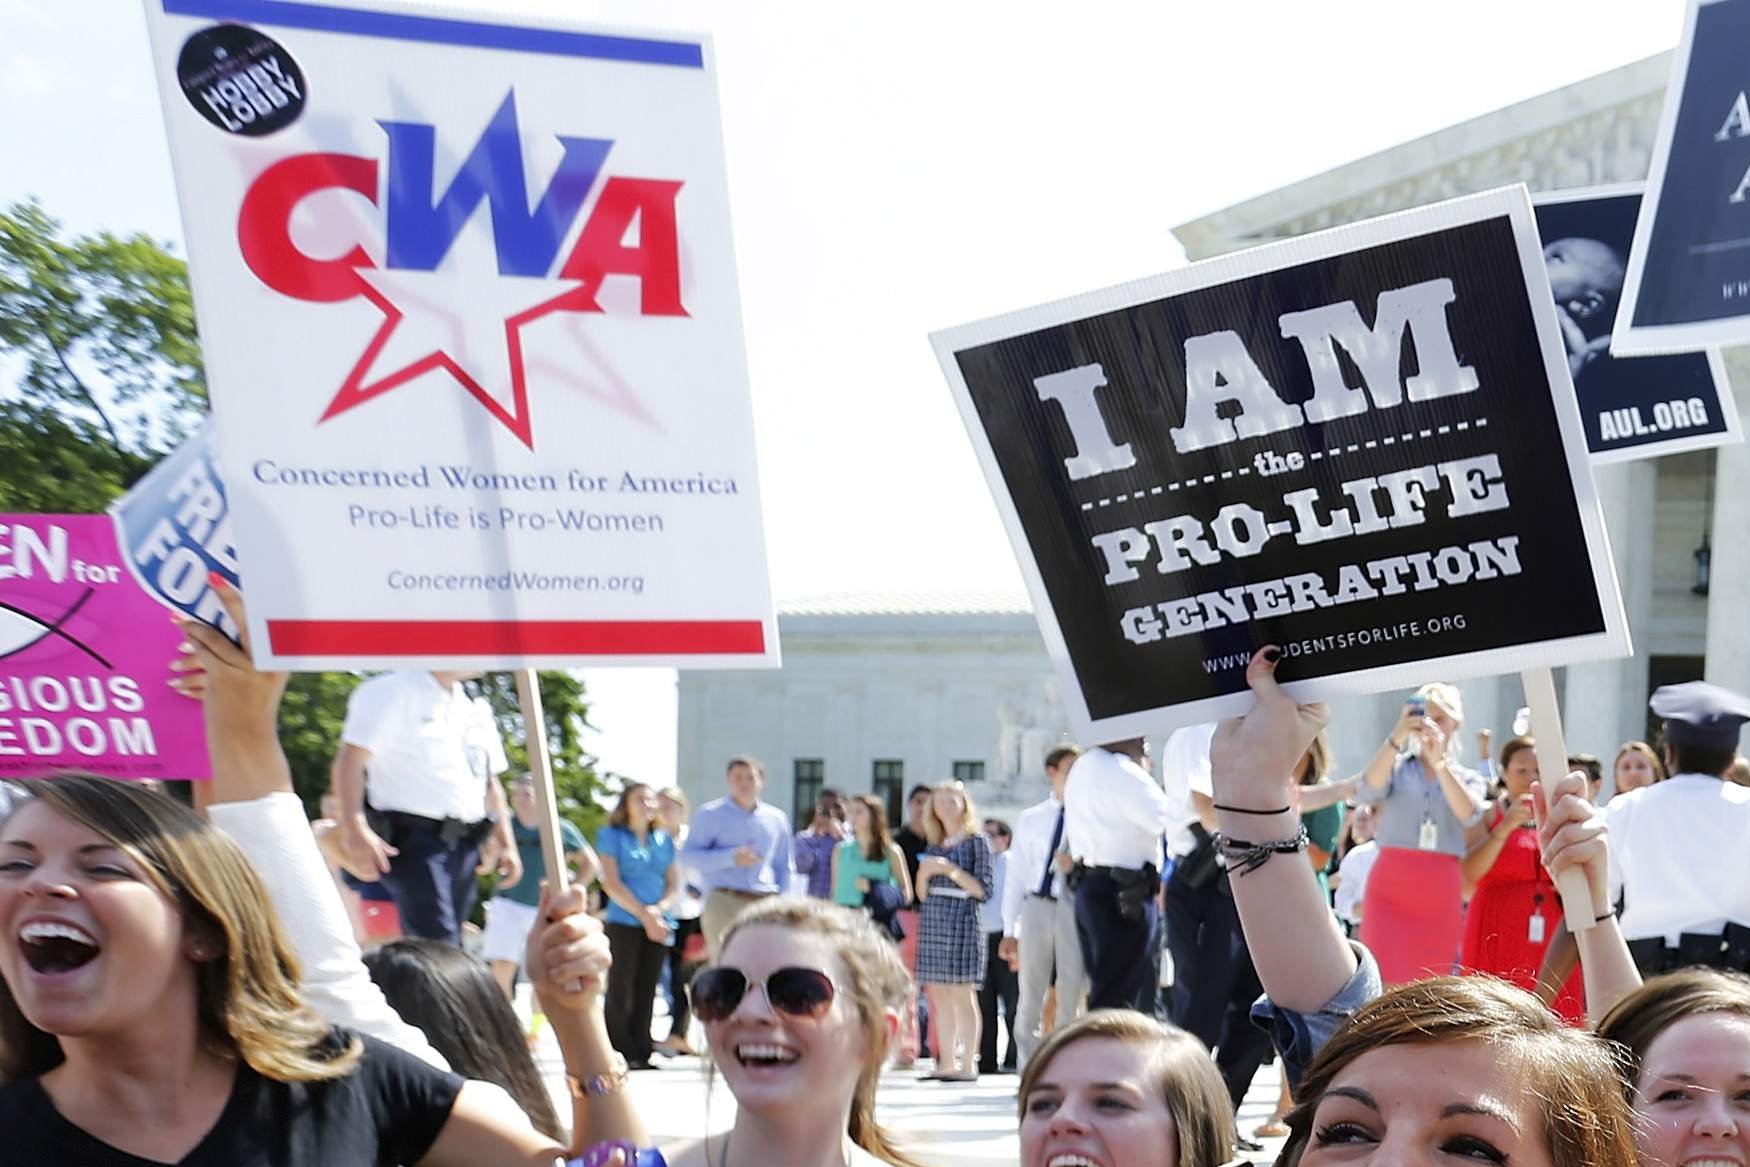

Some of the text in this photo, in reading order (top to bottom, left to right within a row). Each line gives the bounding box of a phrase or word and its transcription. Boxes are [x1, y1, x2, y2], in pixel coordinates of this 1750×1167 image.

[238, 86, 692, 318] CWA
[1033, 277, 1480, 481] I AM
[1600, 397, 1708, 441] AUL.ORG
[253, 459, 738, 495] Concerned Women for America
[1254, 450, 1304, 476] the
[349, 504, 664, 533] Pro-Life is Pro-Women
[1092, 454, 1511, 585] PRO-LIFE
[72, 559, 121, 583] for
[387, 570, 643, 594] ConcernedWomen.org
[1120, 536, 1524, 645] GENERATION
